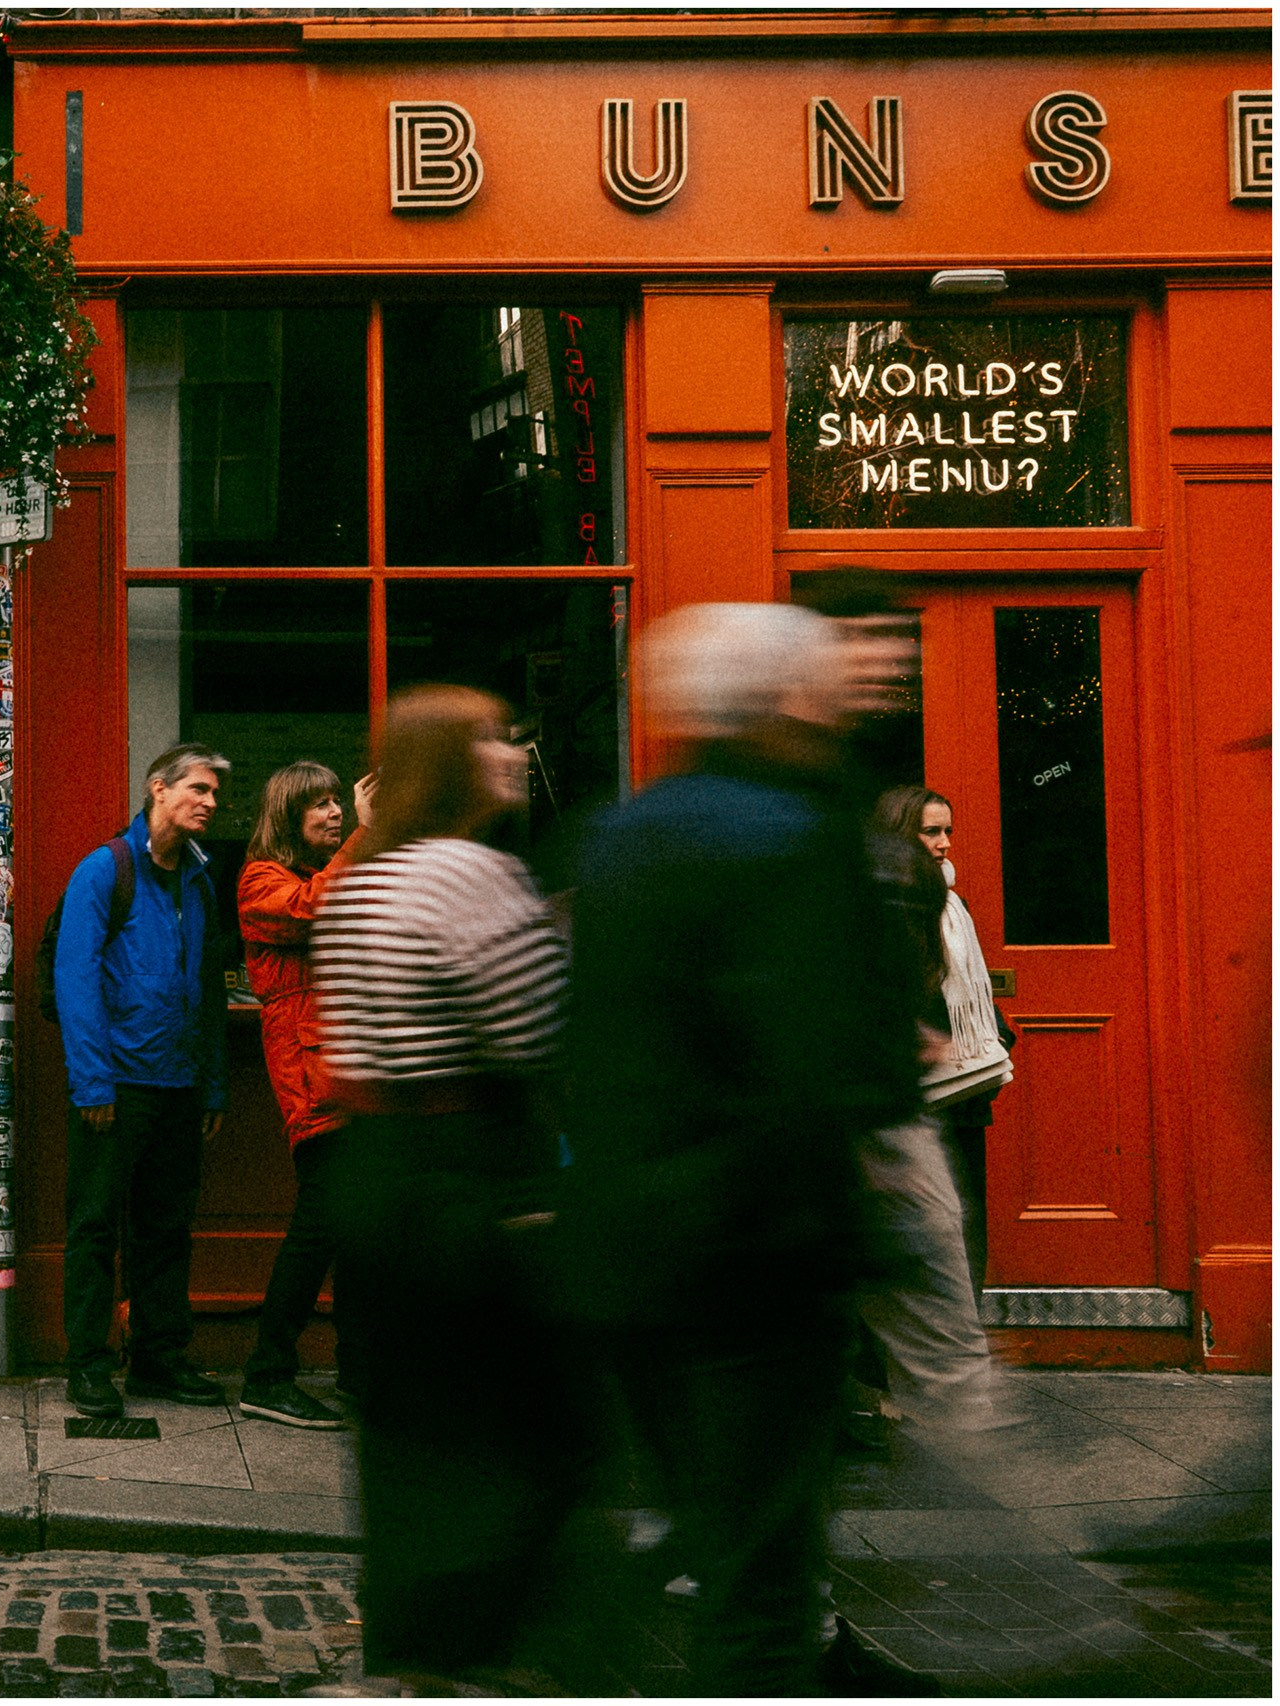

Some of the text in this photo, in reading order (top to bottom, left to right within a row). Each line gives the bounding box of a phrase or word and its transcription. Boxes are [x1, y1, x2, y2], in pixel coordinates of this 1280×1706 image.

[830, 361, 1064, 398] WORLD'S
[819, 410, 1078, 446] SMALLEST
[861, 457, 1040, 494] MENU?
[6, 498, 40, 516] HUR
[1033, 761, 1072, 786] OPEN
